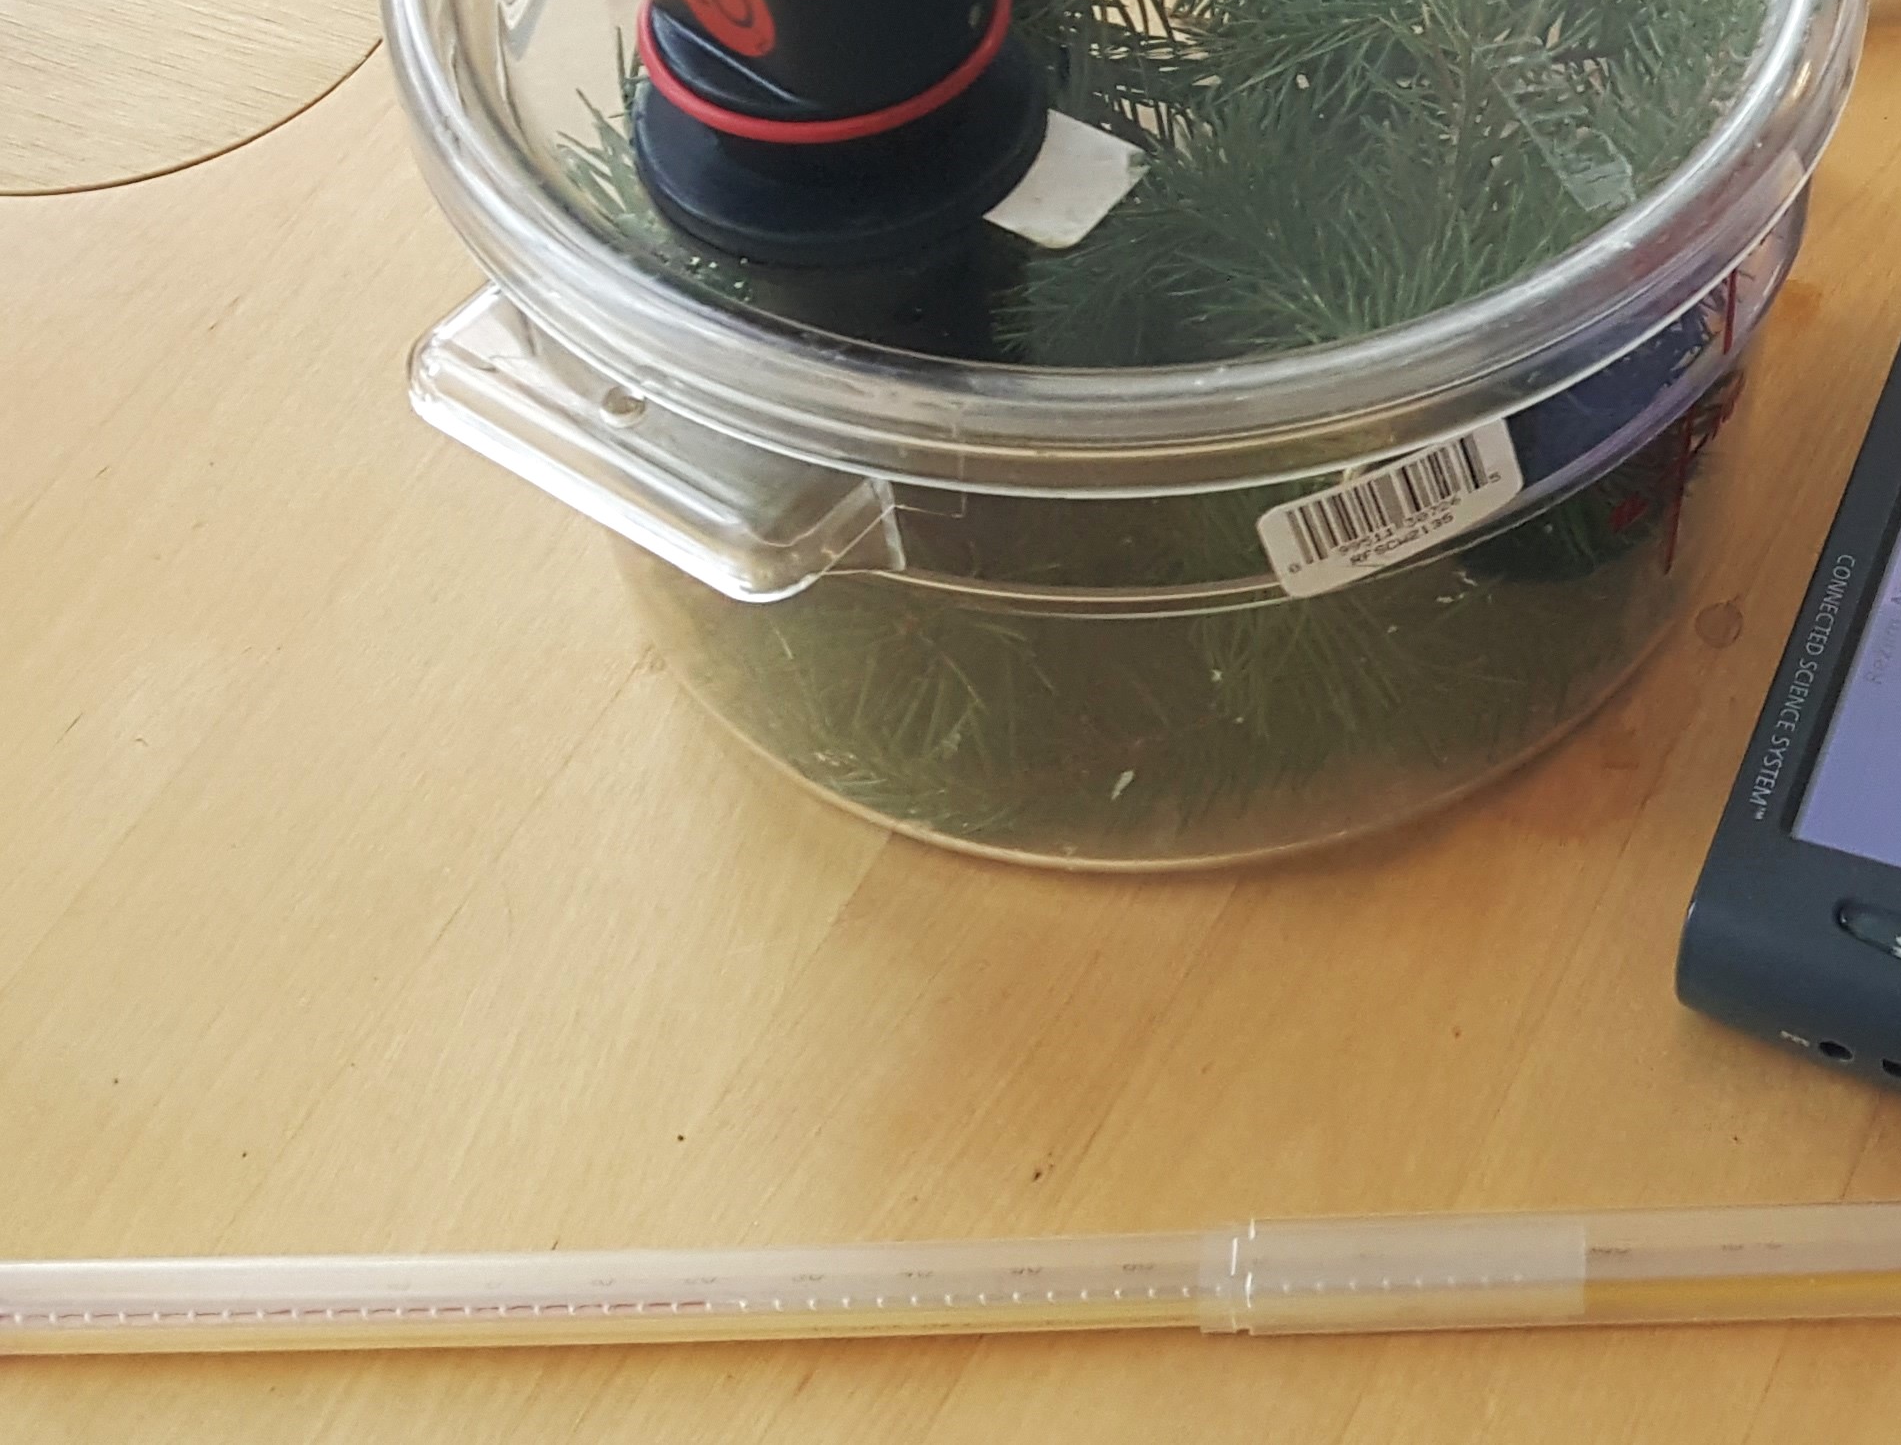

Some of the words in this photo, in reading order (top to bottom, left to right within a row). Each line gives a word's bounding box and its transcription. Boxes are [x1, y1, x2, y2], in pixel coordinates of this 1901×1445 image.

[1488, 470, 1502, 485] 5
[1805, 554, 1856, 656] CONNECTED
[1776, 658, 1818, 732] SCIENCE
